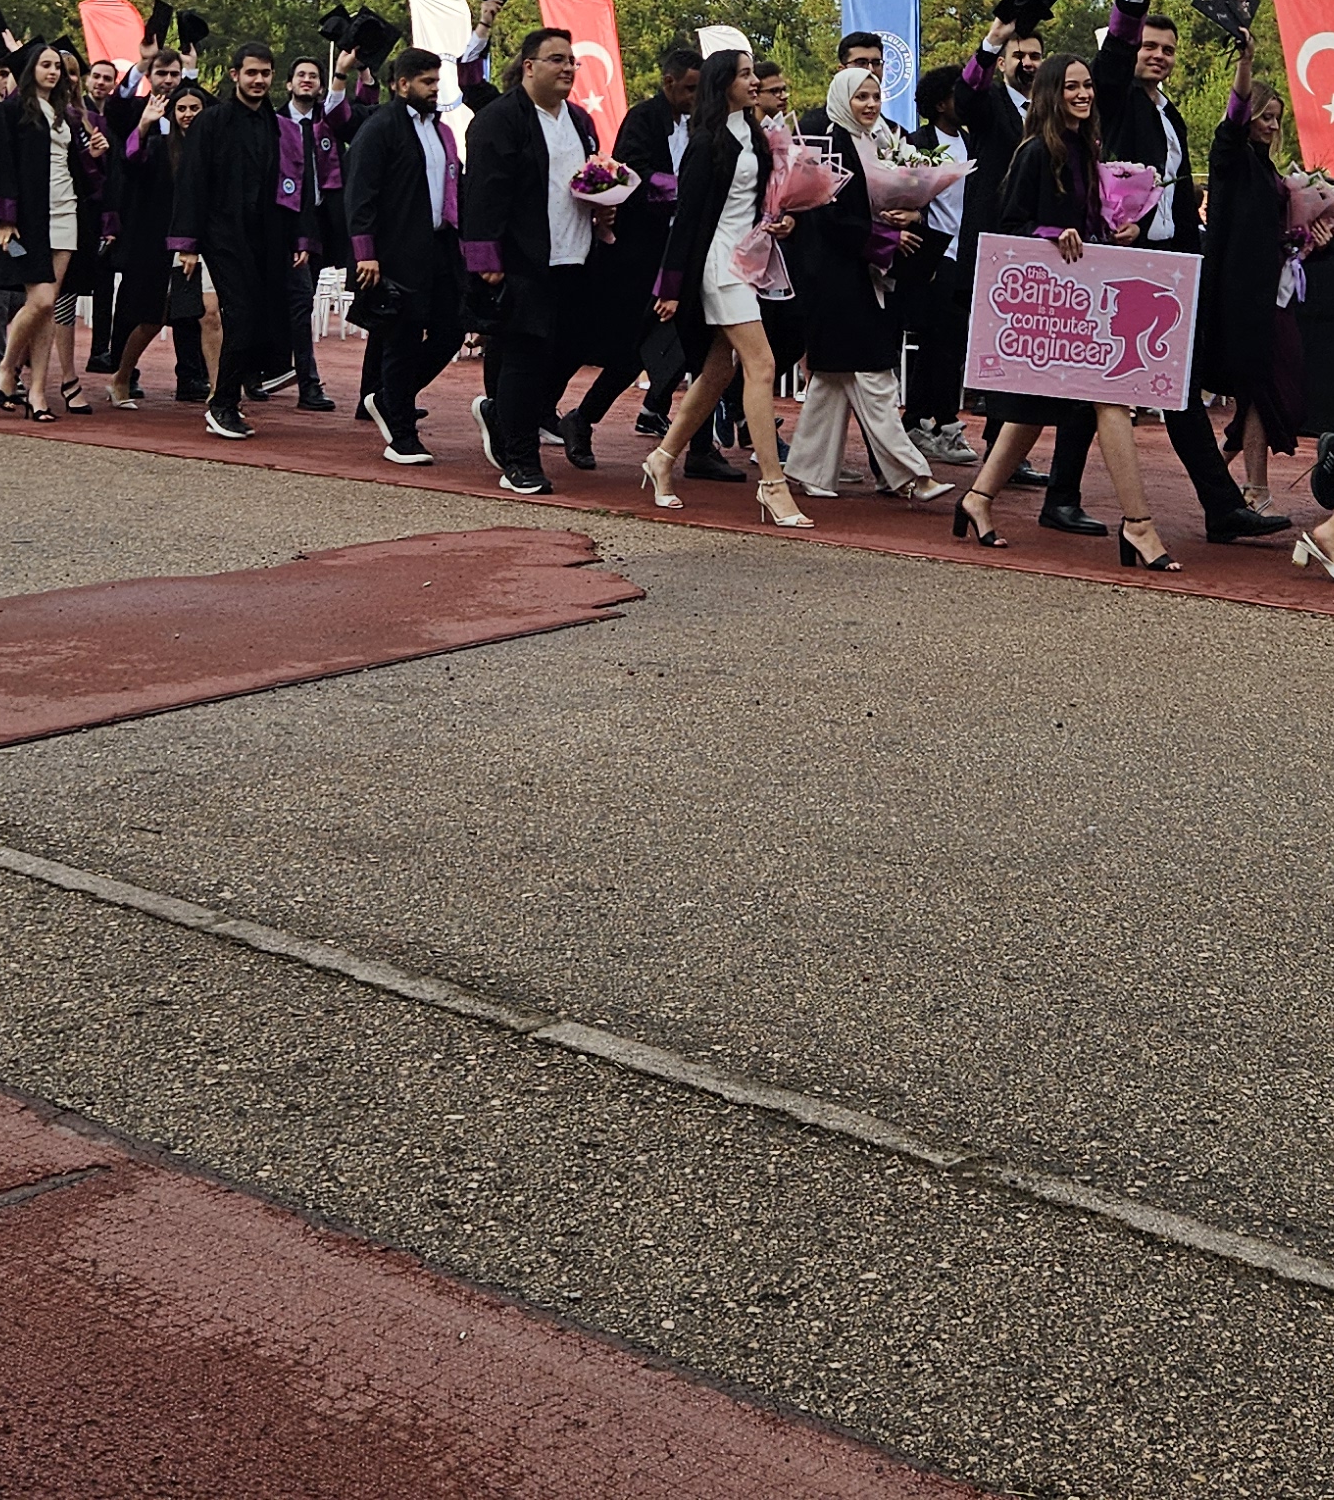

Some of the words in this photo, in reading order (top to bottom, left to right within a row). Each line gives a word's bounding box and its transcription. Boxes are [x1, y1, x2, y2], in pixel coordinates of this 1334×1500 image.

[1027, 267, 1047, 280] this
[993, 269, 1089, 310] Barbie
[1038, 305, 1046, 315] is
[1048, 307, 1055, 316] a
[1012, 313, 1096, 336] computer
[1000, 330, 1111, 365] engineer
